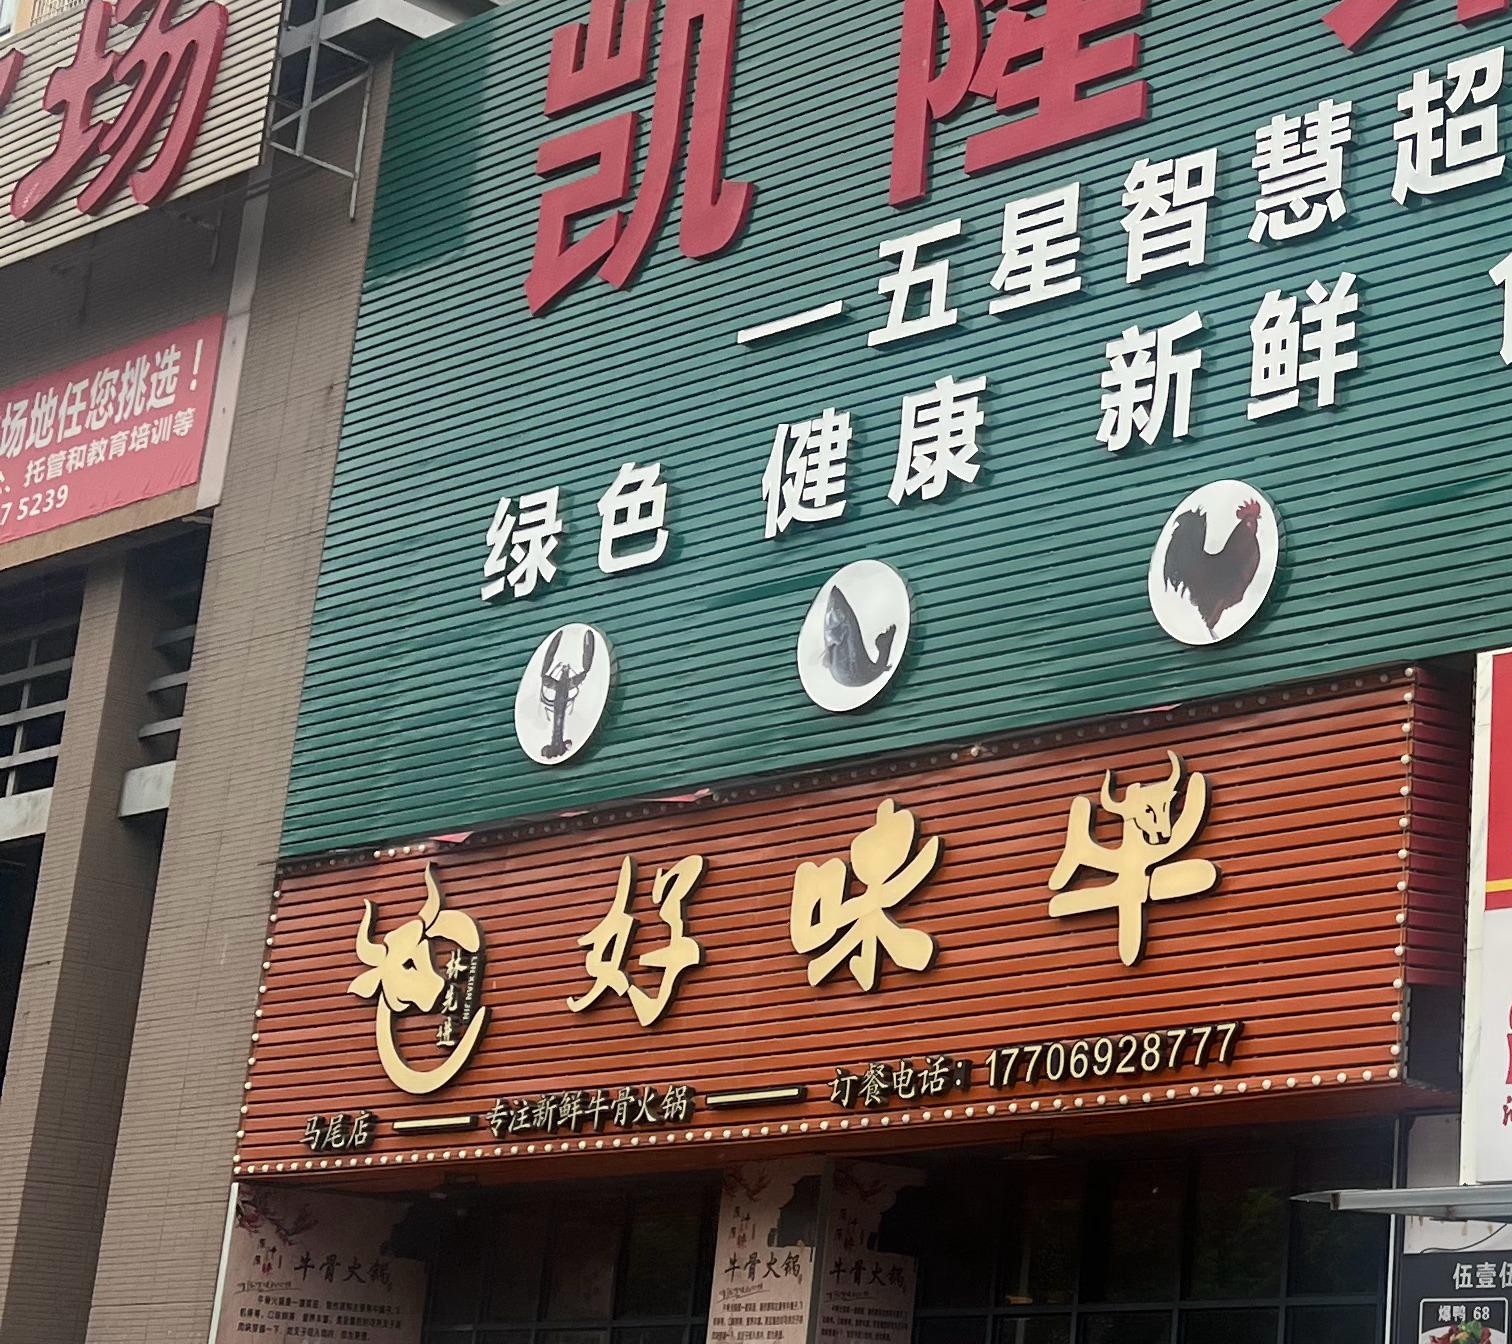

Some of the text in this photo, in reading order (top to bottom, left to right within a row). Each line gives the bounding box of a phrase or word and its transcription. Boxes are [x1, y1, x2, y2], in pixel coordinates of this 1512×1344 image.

[481, 462, 669, 601] 绿色
[762, 376, 987, 538] 健康
[1097, 273, 1359, 452] 新鲜
[17, 485, 68, 520] 5239
[301, 1112, 370, 1151] 马尾店
[486, 1085, 688, 1137] 专注新鲜牛骨火锅
[985, 1023, 1237, 1088] 17706928777
[725, 1251, 800, 1282] 牛骨火锅
[1473, 1306, 1490, 1320] 68
